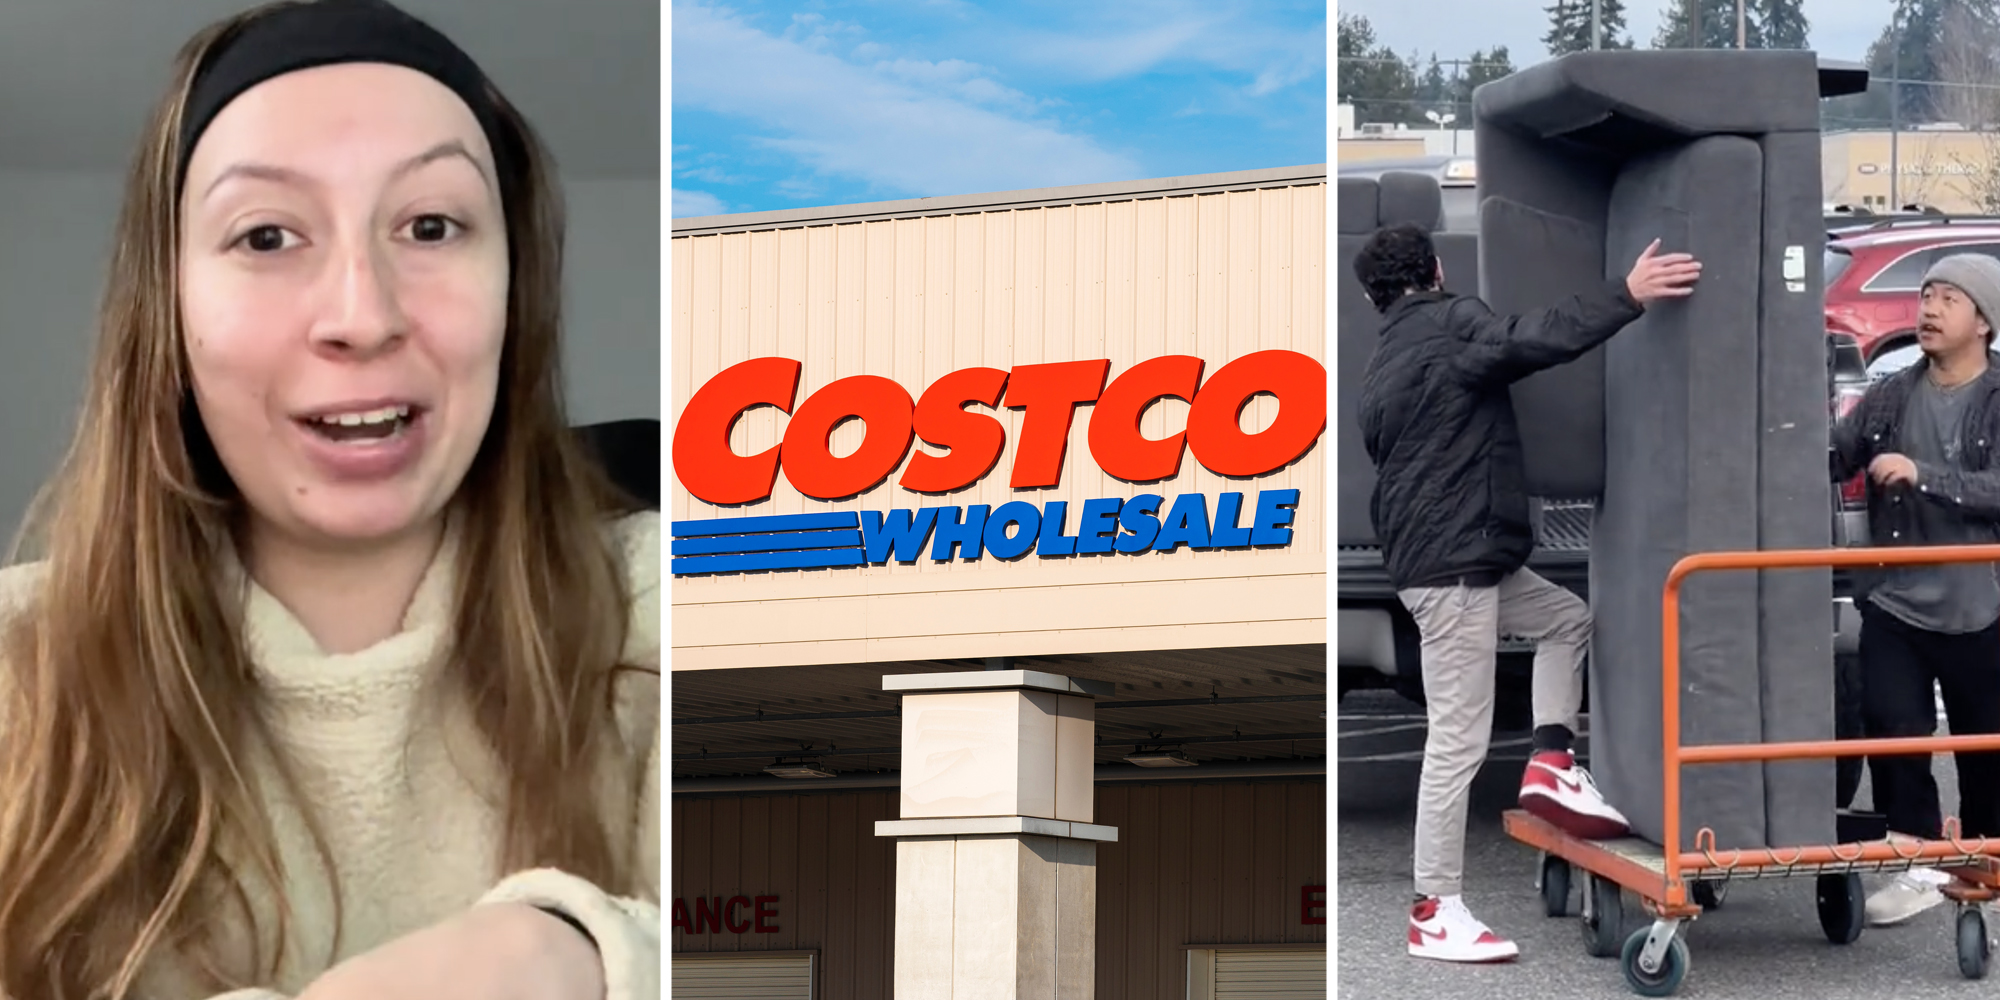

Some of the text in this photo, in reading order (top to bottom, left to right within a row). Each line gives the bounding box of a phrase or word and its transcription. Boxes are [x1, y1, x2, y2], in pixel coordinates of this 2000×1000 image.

[672, 350, 1326, 506] COSTCO
[862, 488, 1299, 564] WHOLESALE
[672, 895, 780, 935] ANCE
